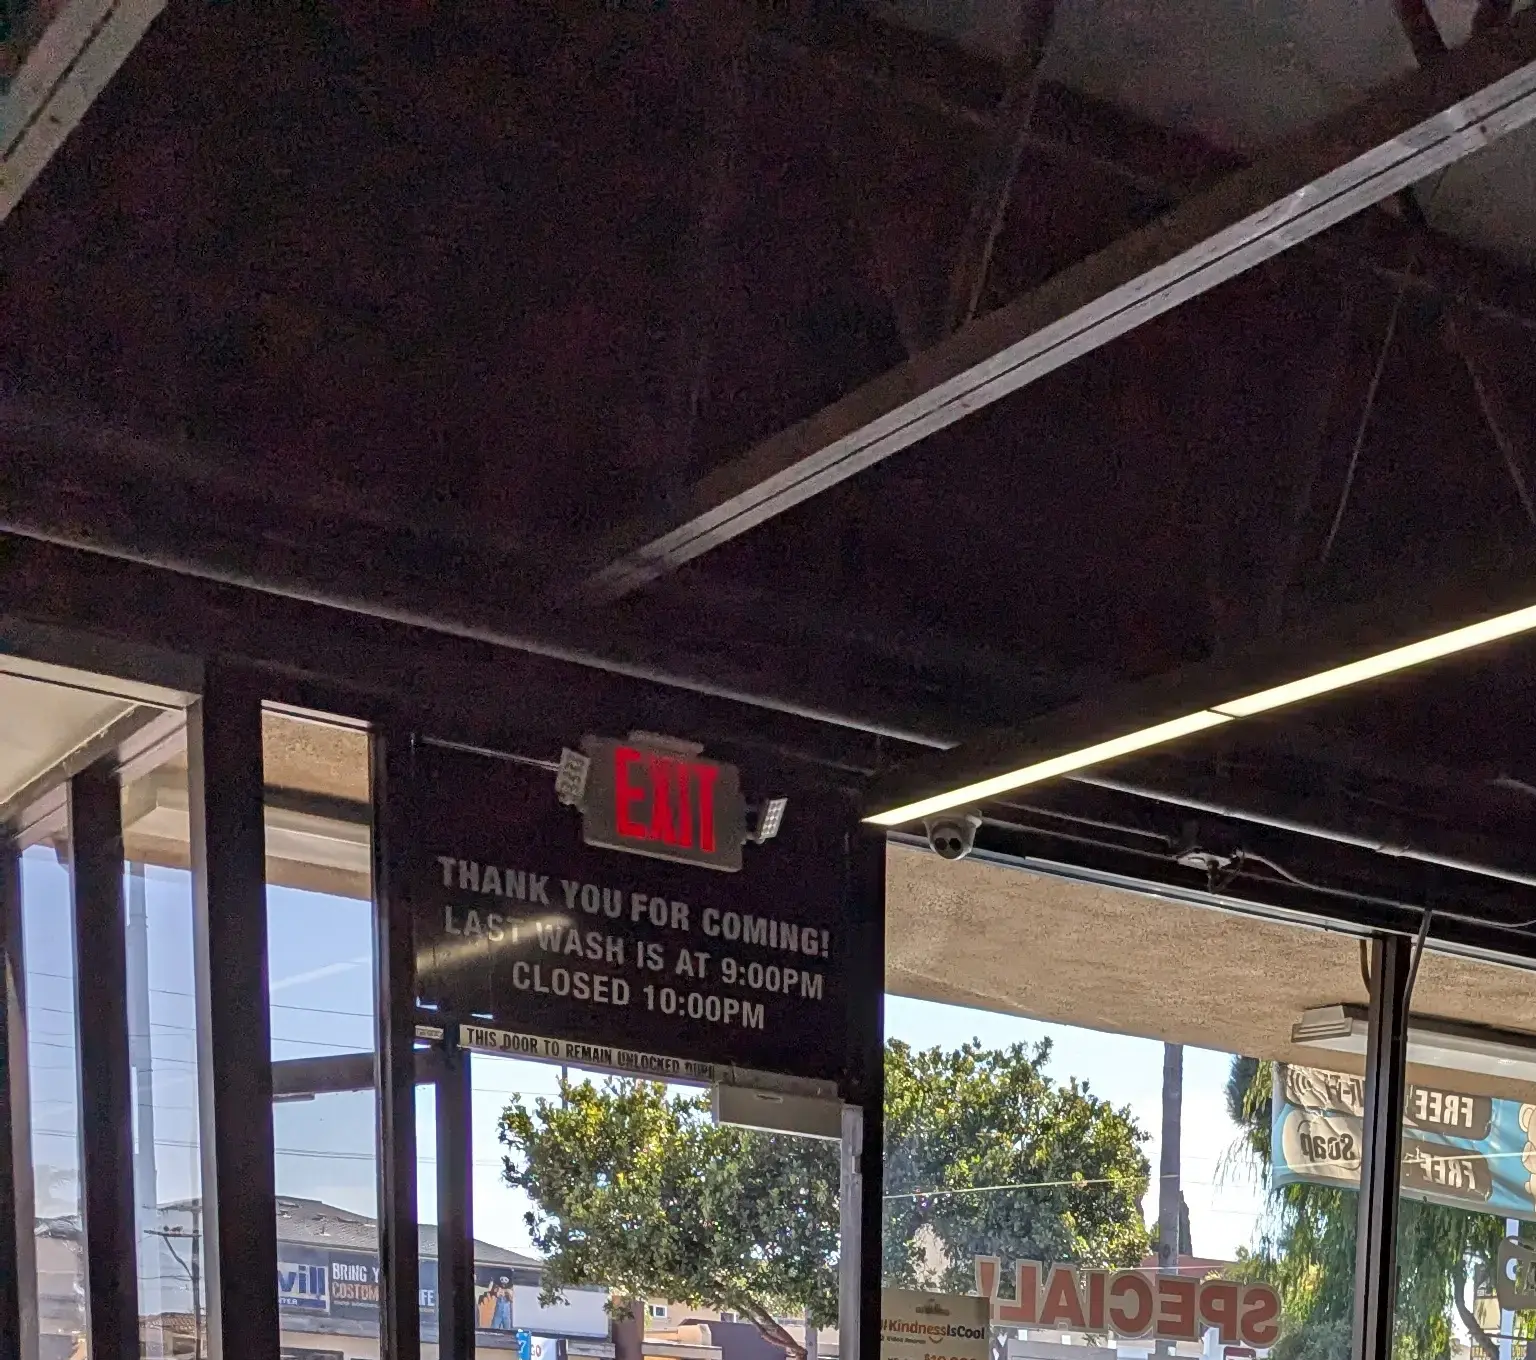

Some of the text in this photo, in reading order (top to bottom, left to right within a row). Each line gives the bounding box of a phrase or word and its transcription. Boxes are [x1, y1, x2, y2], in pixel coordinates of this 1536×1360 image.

[615, 746, 719, 853] EXIT
[437, 856, 830, 958] THANK YOU FOR COMING!
[445, 905, 823, 1001] LAST WASH IS AT 9:00PM
[512, 961, 766, 1030] CLOSED 10:00PM
[466, 1027, 497, 1048] THIS
[502, 1034, 538, 1056] DOOR
[544, 1039, 559, 1057] TO
[565, 1044, 612, 1066] REMAIN
[617, 1051, 680, 1075] UNLOCKED
[332, 1262, 368, 1283] BRING
[419, 1289, 434, 1307] IFE
